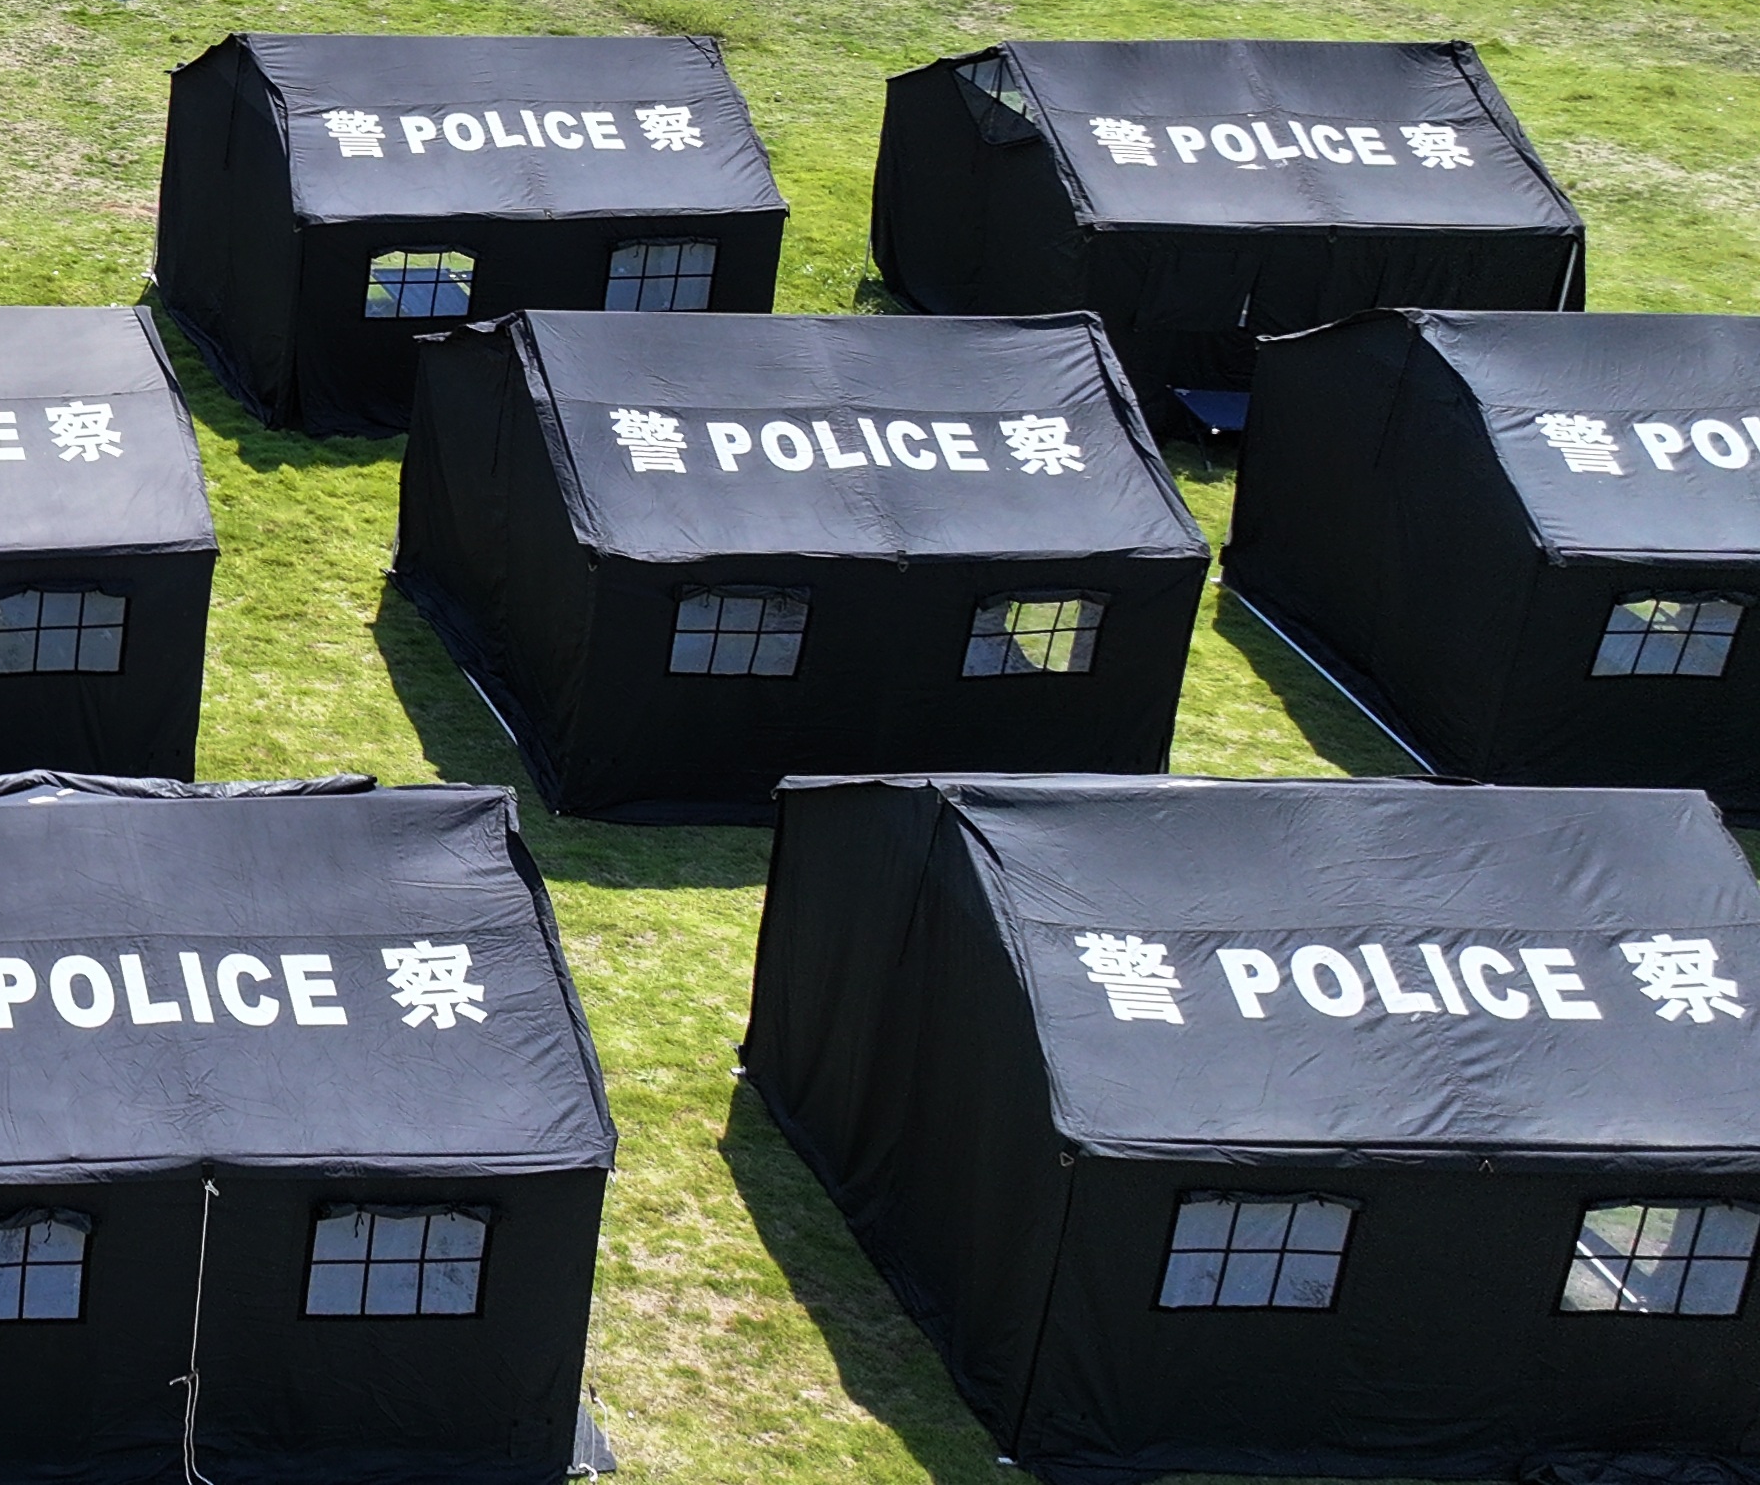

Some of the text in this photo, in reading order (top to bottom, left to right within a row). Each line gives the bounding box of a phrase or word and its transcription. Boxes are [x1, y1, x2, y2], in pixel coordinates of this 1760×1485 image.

[322, 105, 703, 157] 警 POLICE 察
[1090, 118, 1474, 169] 警 POLICE 察
[45, 401, 123, 461] 察
[610, 408, 1085, 475] 警 POLICE 察
[1536, 414, 1624, 475] 警
[381, 940, 487, 1029] 察
[1075, 932, 1746, 1024] 警 POLICE 察
